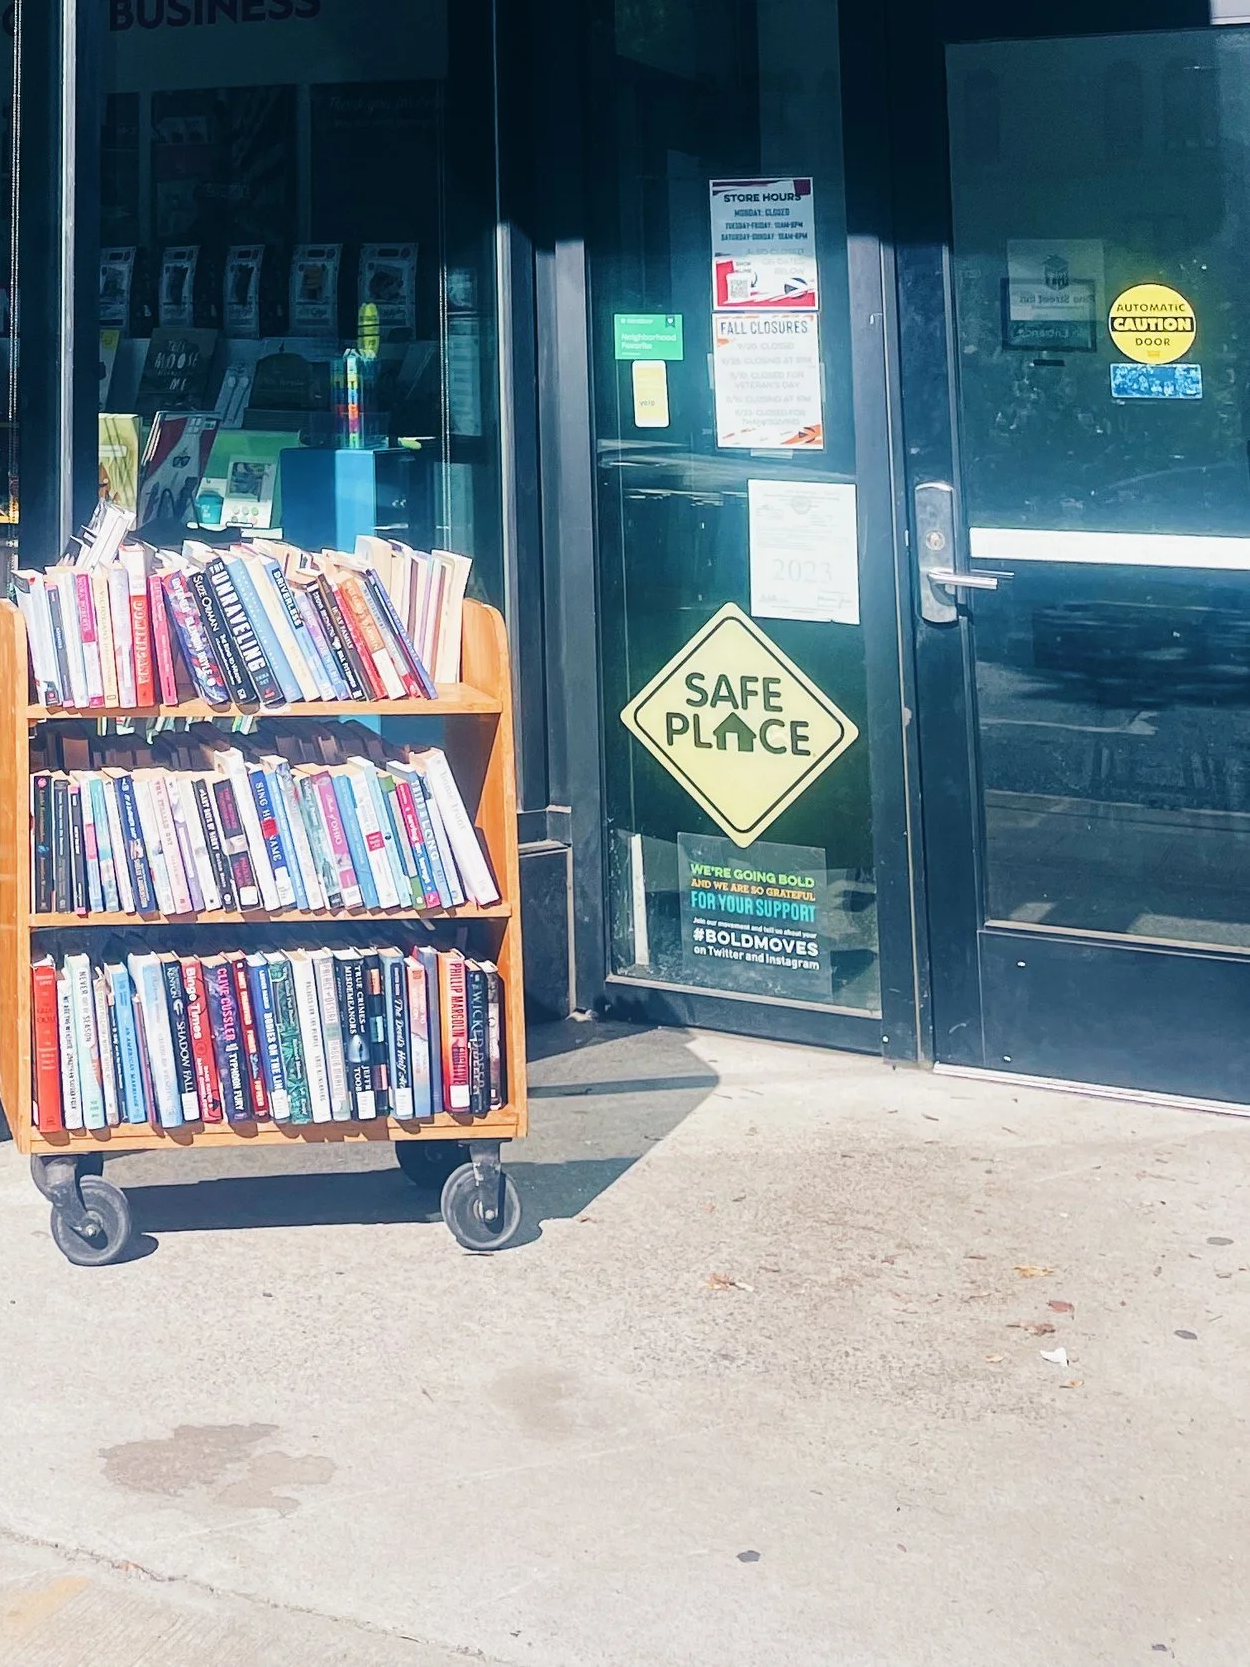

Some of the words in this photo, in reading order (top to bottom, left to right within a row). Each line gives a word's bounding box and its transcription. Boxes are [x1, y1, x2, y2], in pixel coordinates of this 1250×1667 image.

[724, 193, 760, 202] STORE
[762, 192, 801, 202] HOURS
[1116, 303, 1186, 313] AUTOMATIC
[721, 322, 747, 334] FALL
[750, 320, 808, 334] CLOSURES
[1113, 317, 1192, 332] CAUTION
[1135, 337, 1170, 346] DOOR
[154, 352, 199, 369] MOOSE
[772, 559, 832, 583] 2023
[192, 573, 208, 597] SUZE
[200, 595, 222, 631] ORMAN
[272, 570, 301, 627] DRIVERLESS
[211, 570, 267, 672] UNRAVELING
[132, 600, 149, 684] DOMINICANA
[339, 625, 353, 650] FAMILY
[685, 672, 784, 712] SAFE
[255, 781, 268, 806] SING
[330, 820, 344, 845] OHIO
[690, 864, 731, 878] WE'RE
[733, 869, 776, 883] GOING
[778, 874, 815, 888] BOLD
[691, 879, 711, 889] AND
[713, 882, 729, 891] WE
[730, 884, 749, 893] ARE
[750, 886, 764, 895] SO
[765, 888, 815, 901] GRATEFUL
[691, 892, 715, 909] FOR
[717, 894, 754, 916] YOUR
[756, 899, 816, 922] SUPPORT
[751, 923, 762, 932] and
[693, 927, 819, 957] #BOLDMOVES
[694, 947, 706, 955] on
[708, 945, 744, 960] Twitter
[745, 952, 764, 963] and
[766, 954, 820, 970] Instagram
[184, 966, 199, 1001] Bingo
[217, 967, 230, 995] CLIVE
[321, 964, 332, 990] PALACE
[353, 965, 362, 989] TRUE
[448, 963, 462, 993] PHILLIP
[78, 971, 87, 994] NEVER
[83, 1015, 91, 1042] SEASON
[325, 997, 336, 1022] DESIRE
[342, 966, 357, 1034] MISDEMEANORS
[356, 991, 366, 1023] CRIMES
[394, 999, 403, 1016] The
[167, 967, 178, 998] KENYON
[176, 1020, 191, 1067] SHADOW
[189, 1003, 203, 1039] Times
[220, 997, 235, 1040] CUSSLER
[263, 1012, 275, 1042] BODIES
[450, 995, 464, 1037] MARGOLIN
[469, 992, 483, 1046] WICKED
[394, 1019, 405, 1047] Devil's
[125, 1037, 134, 1071] AMERICAN
[270, 1057, 280, 1073] THE
[396, 1050, 406, 1071] Half
[451, 1046, 467, 1085] FUGITIVE
[229, 1053, 240, 1089] TYPHOON
[272, 1075, 282, 1092] LIN
[129, 1073, 138, 1106] MARRIAGE
[233, 1090, 243, 1109] FURY
